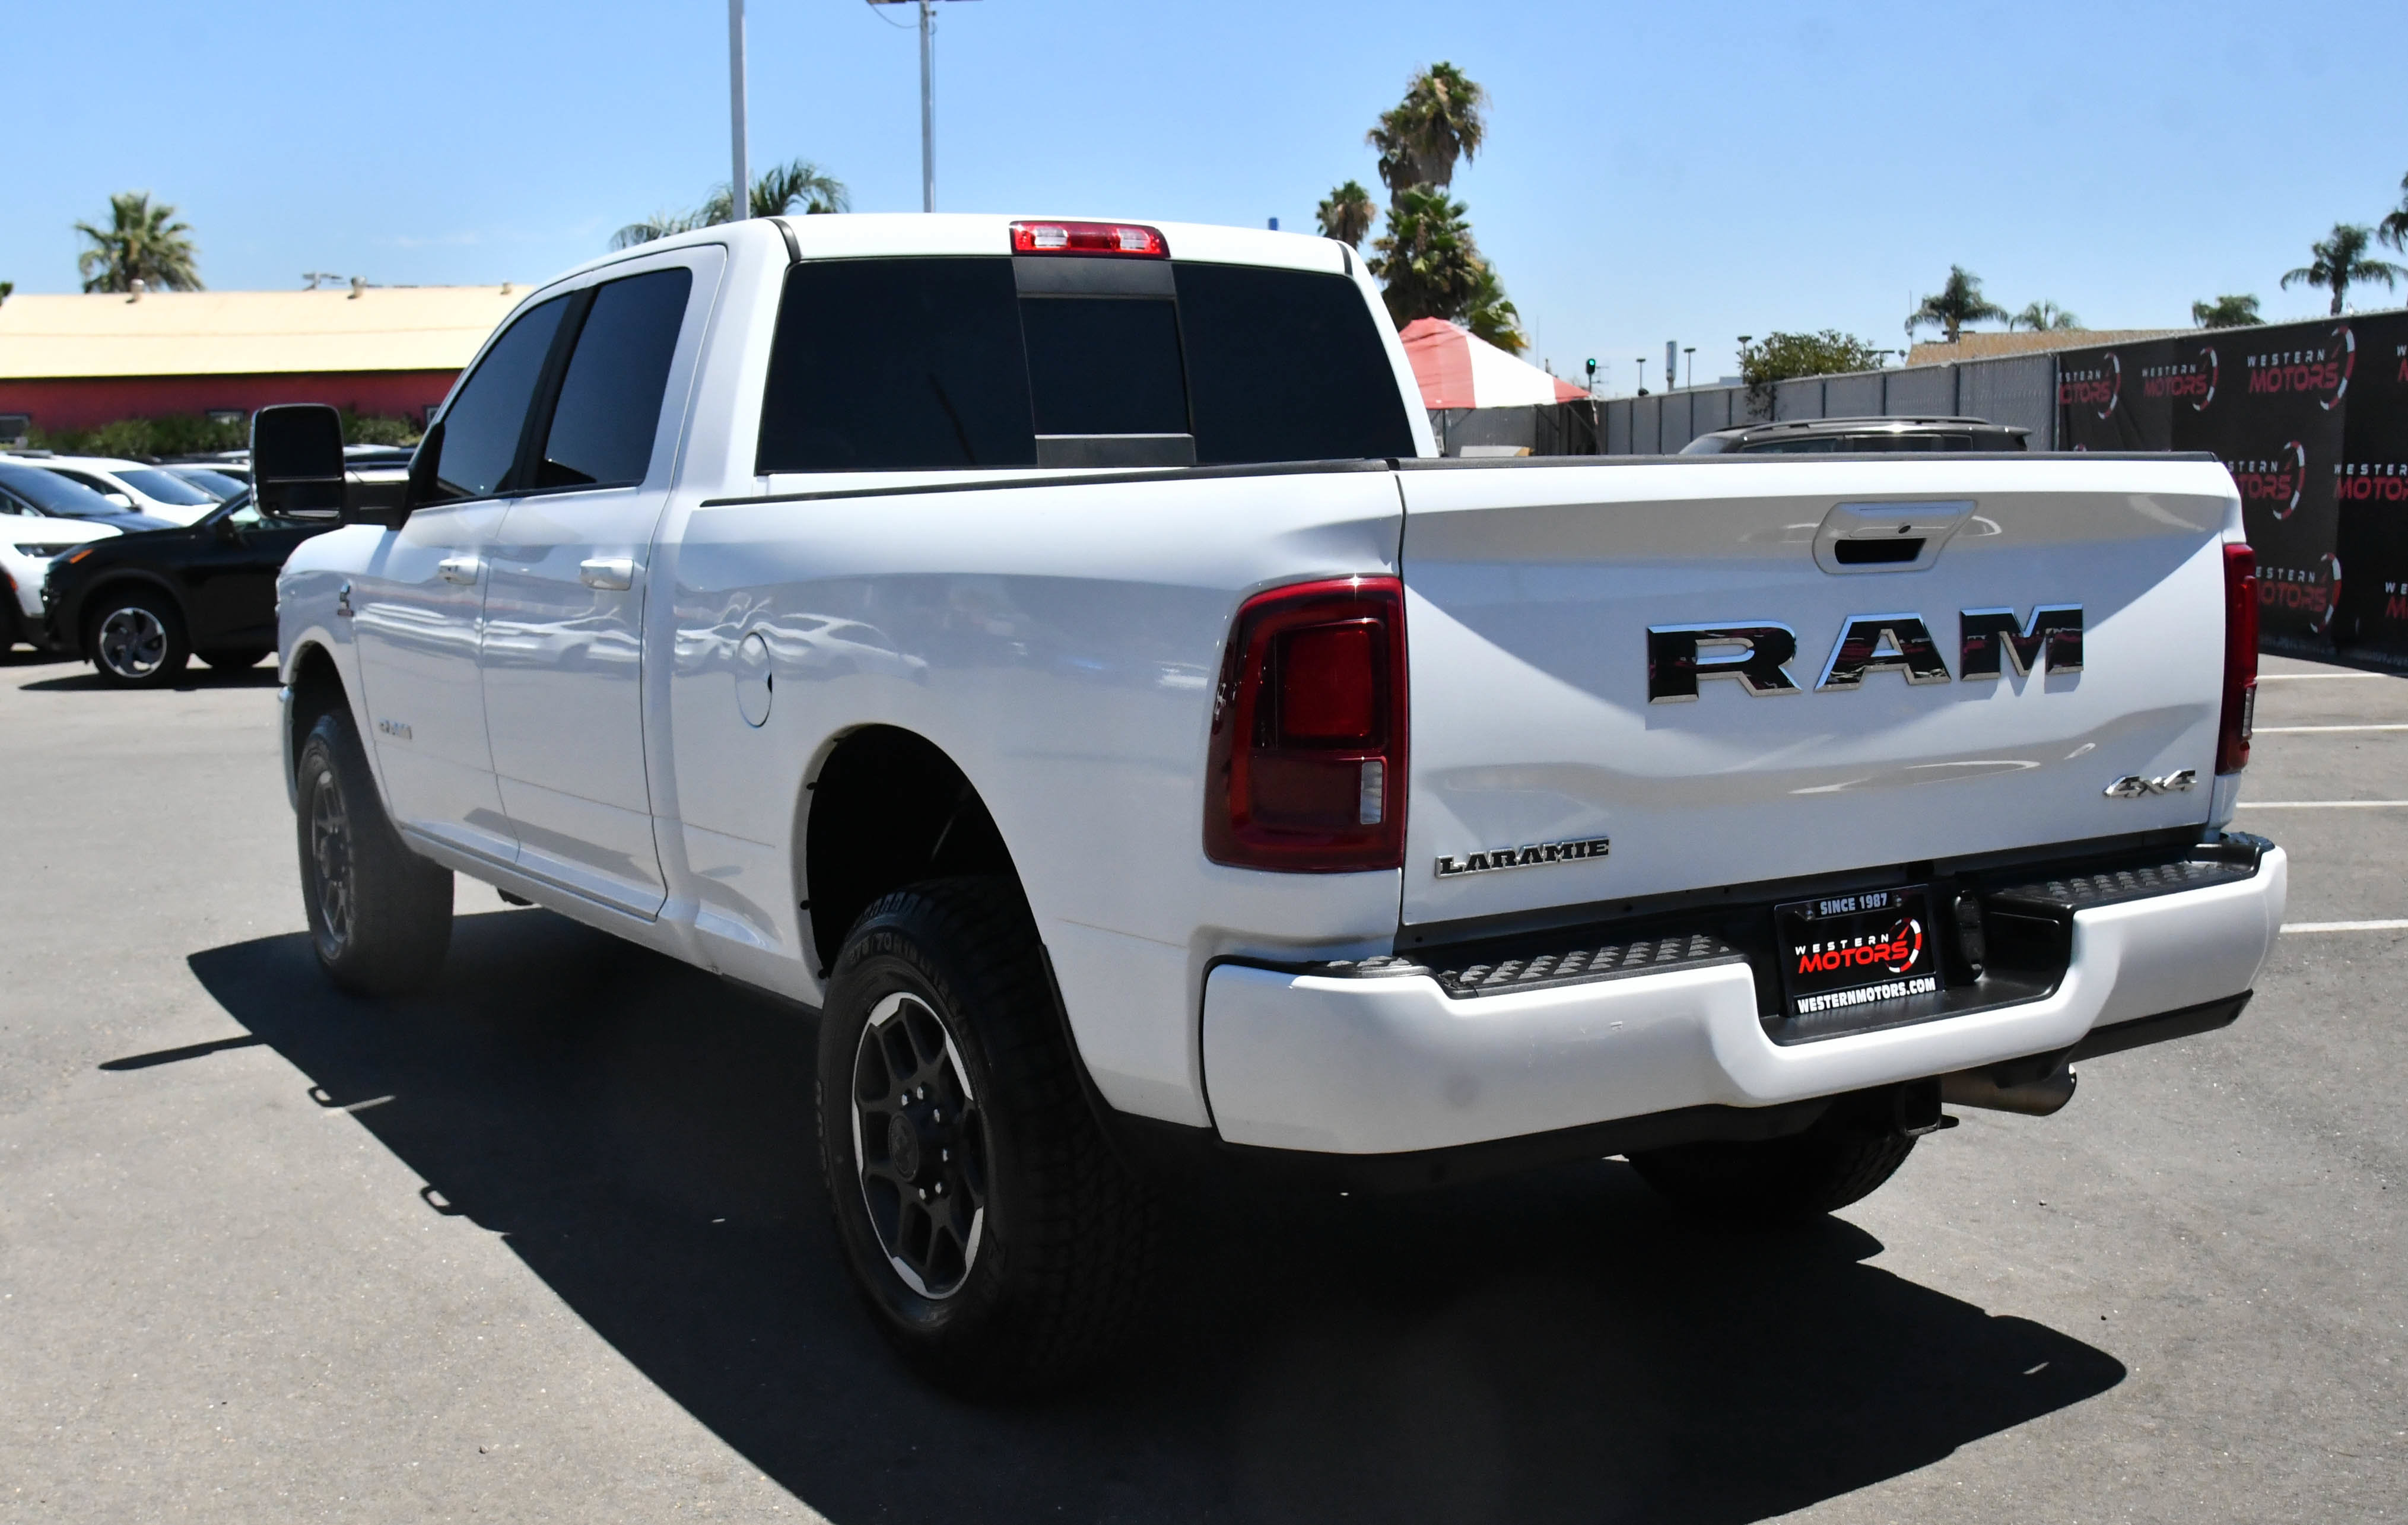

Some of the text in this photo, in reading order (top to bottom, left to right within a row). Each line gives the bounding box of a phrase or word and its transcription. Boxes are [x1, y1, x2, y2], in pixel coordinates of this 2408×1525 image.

[2247, 349, 2326, 367] WESTERN
[2142, 364, 2196, 377] WESTERN
[2248, 362, 2339, 393] MOTORS
[2143, 374, 2207, 398] MOTORS
[2334, 463, 2408, 476] WESTER
[1647, 603, 2083, 703] RAM
[1435, 836, 1609, 878] LARAMIE
[1820, 892, 1888, 916] SINCE 1987
[1795, 933, 1889, 956] WESTERN
[1799, 941, 1908, 974] MOTORS
[1797, 977, 1936, 1014] WESTERNMOTORS.COM
